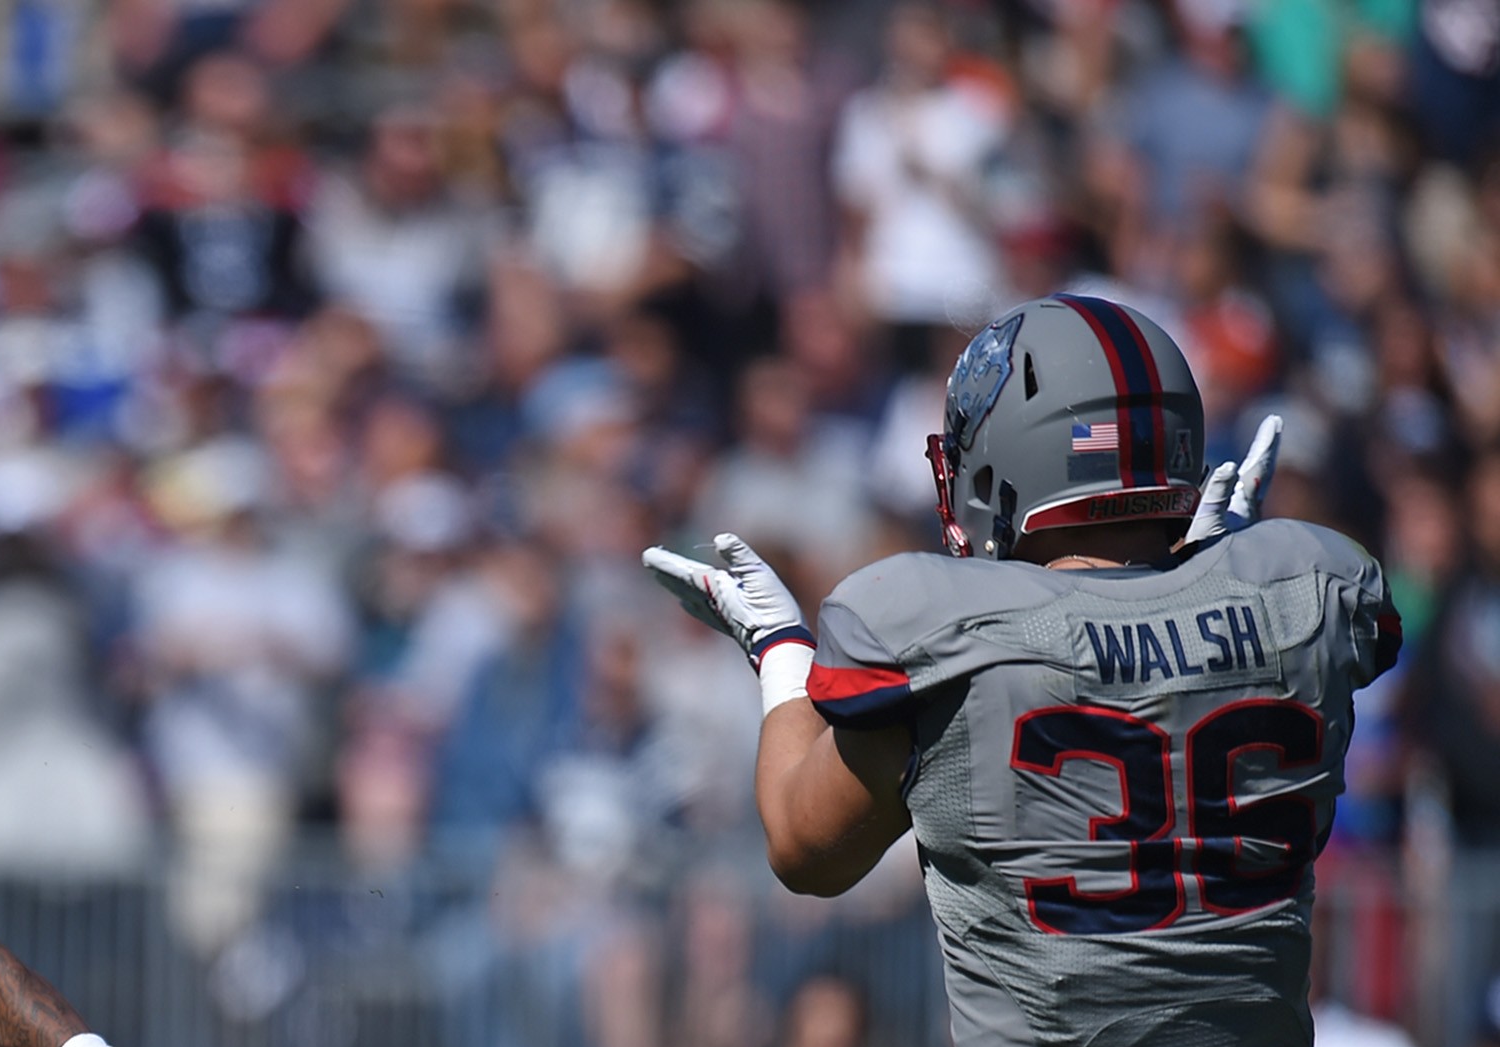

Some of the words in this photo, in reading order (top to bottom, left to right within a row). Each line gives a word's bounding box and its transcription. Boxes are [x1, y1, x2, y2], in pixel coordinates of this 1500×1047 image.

[1089, 491, 1194, 518] HUSKIES
[1085, 605, 1266, 685] WALSH
[1010, 697, 1324, 936] 36
